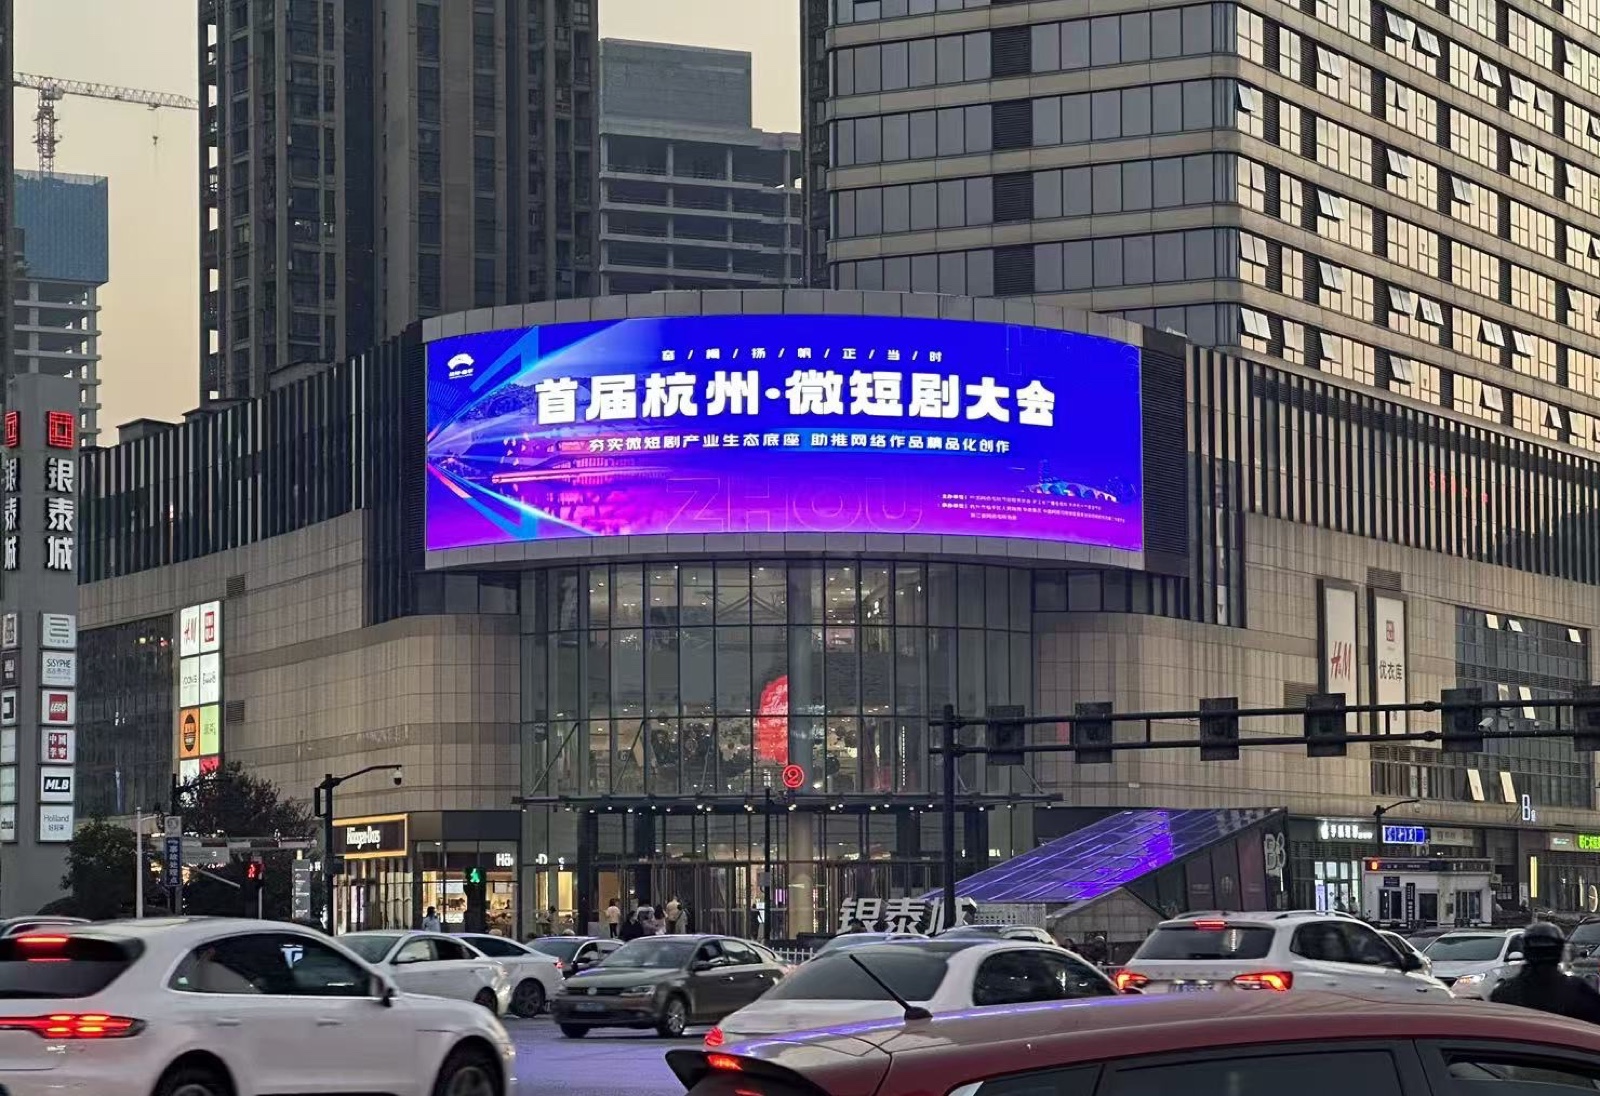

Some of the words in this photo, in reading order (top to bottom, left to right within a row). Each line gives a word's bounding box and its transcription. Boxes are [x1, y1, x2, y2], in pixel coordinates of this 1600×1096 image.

[535, 369, 1056, 427] 首届杭州·微短剧大会
[589, 433, 800, 453] 夯实微短剧产业生态底座
[811, 433, 1011, 454] 助推网络作品精品化创作
[47, 457, 74, 571] 银泰城
[1379, 660, 1403, 682] 优衣库
[45, 779, 69, 790] MLB
